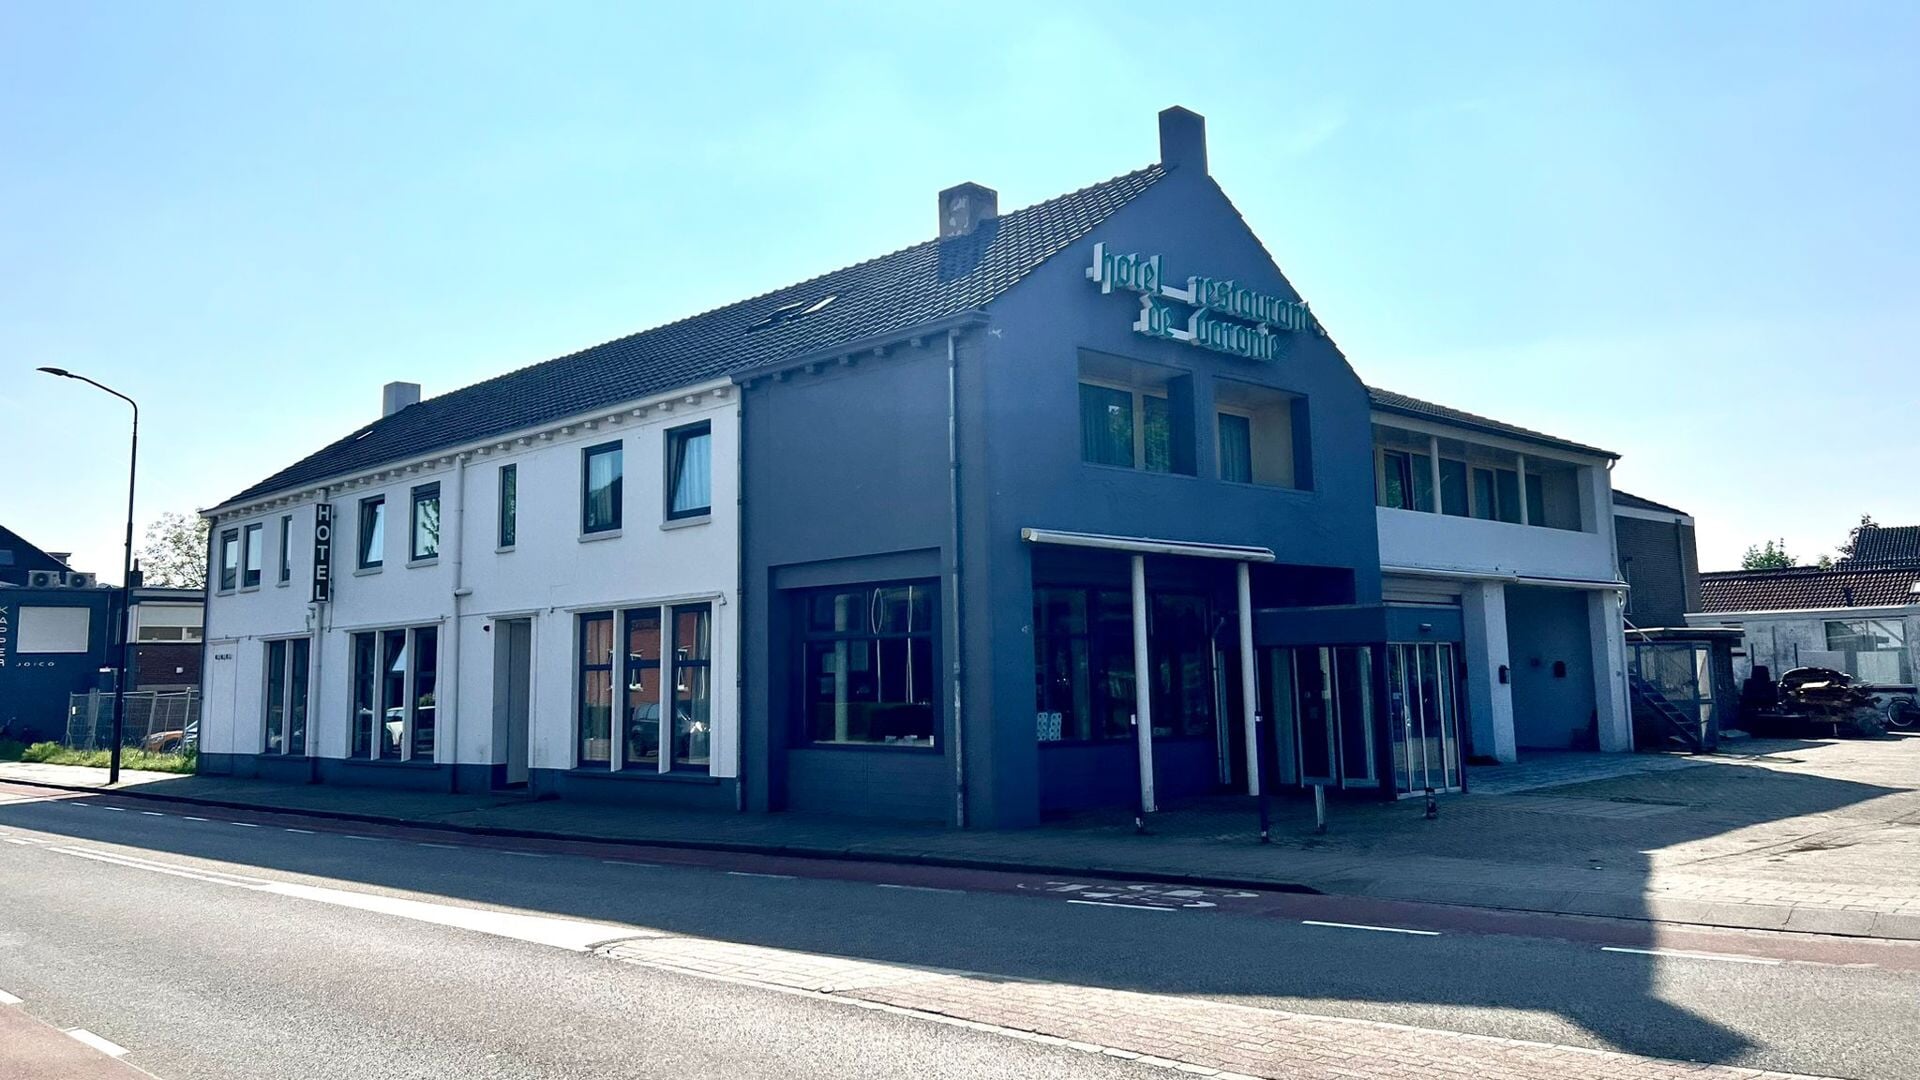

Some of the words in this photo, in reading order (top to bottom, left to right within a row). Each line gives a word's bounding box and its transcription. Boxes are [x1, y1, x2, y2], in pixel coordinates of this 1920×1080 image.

[1093, 241, 1163, 295] hotel
[1187, 276, 1311, 332] restaurant
[1139, 293, 1174, 337] de
[316, 505, 331, 600] HOTEL
